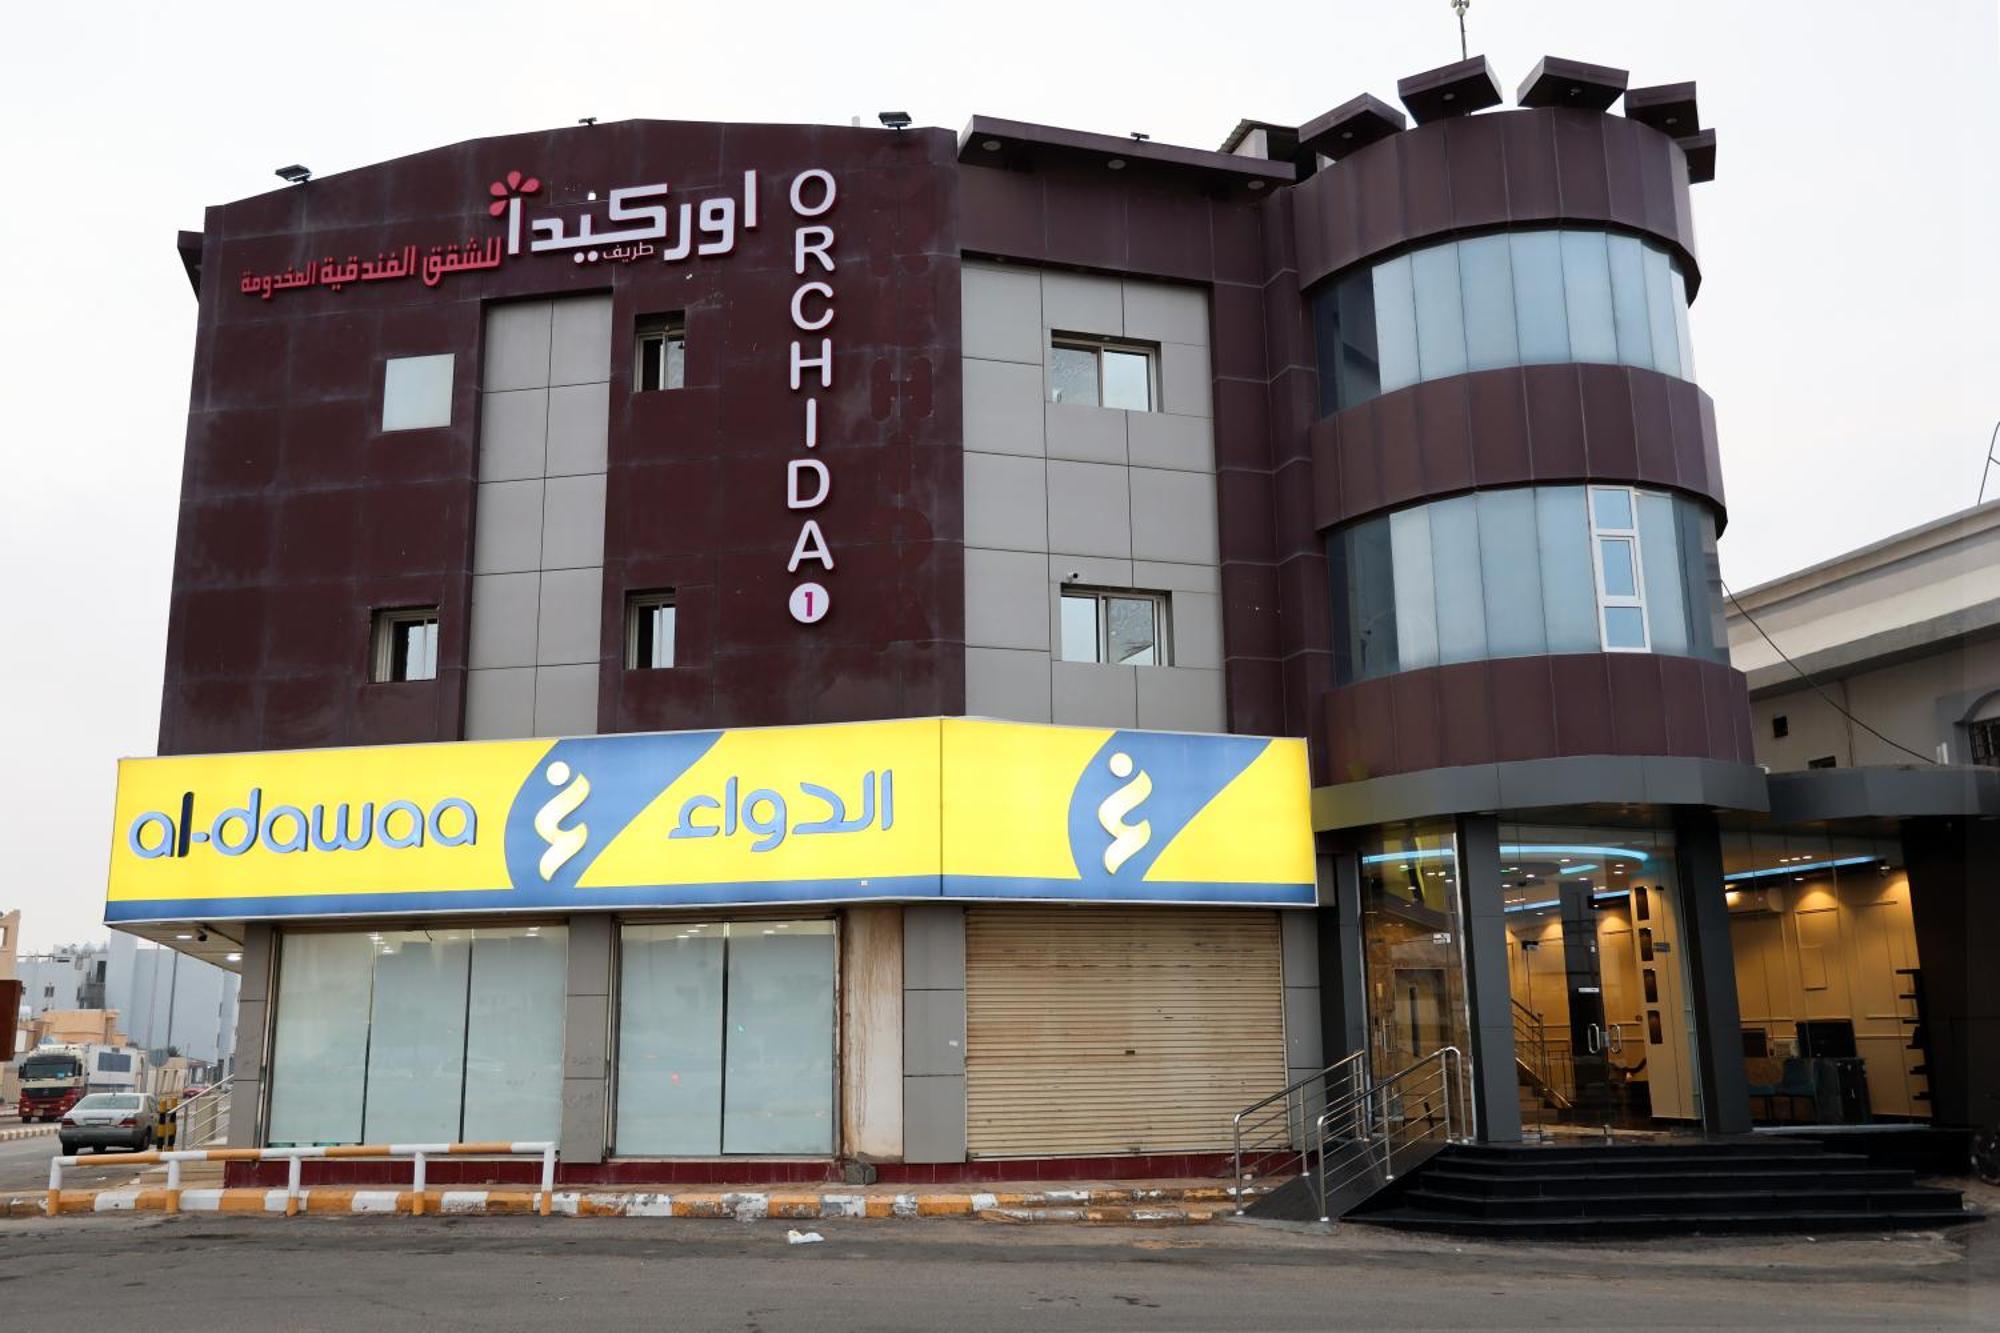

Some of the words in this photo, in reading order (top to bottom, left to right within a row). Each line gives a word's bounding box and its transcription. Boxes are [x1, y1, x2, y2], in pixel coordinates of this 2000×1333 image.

[320, 245, 417, 290] الفندقية
[422, 236, 501, 286] للشقق
[602, 241, 654, 263] طريف
[240, 261, 317, 299] المخدومة
[787, 168, 837, 573] ORCHIDA
[128, 787, 478, 859] al-dawaa
[668, 769, 894, 852] الدواء
